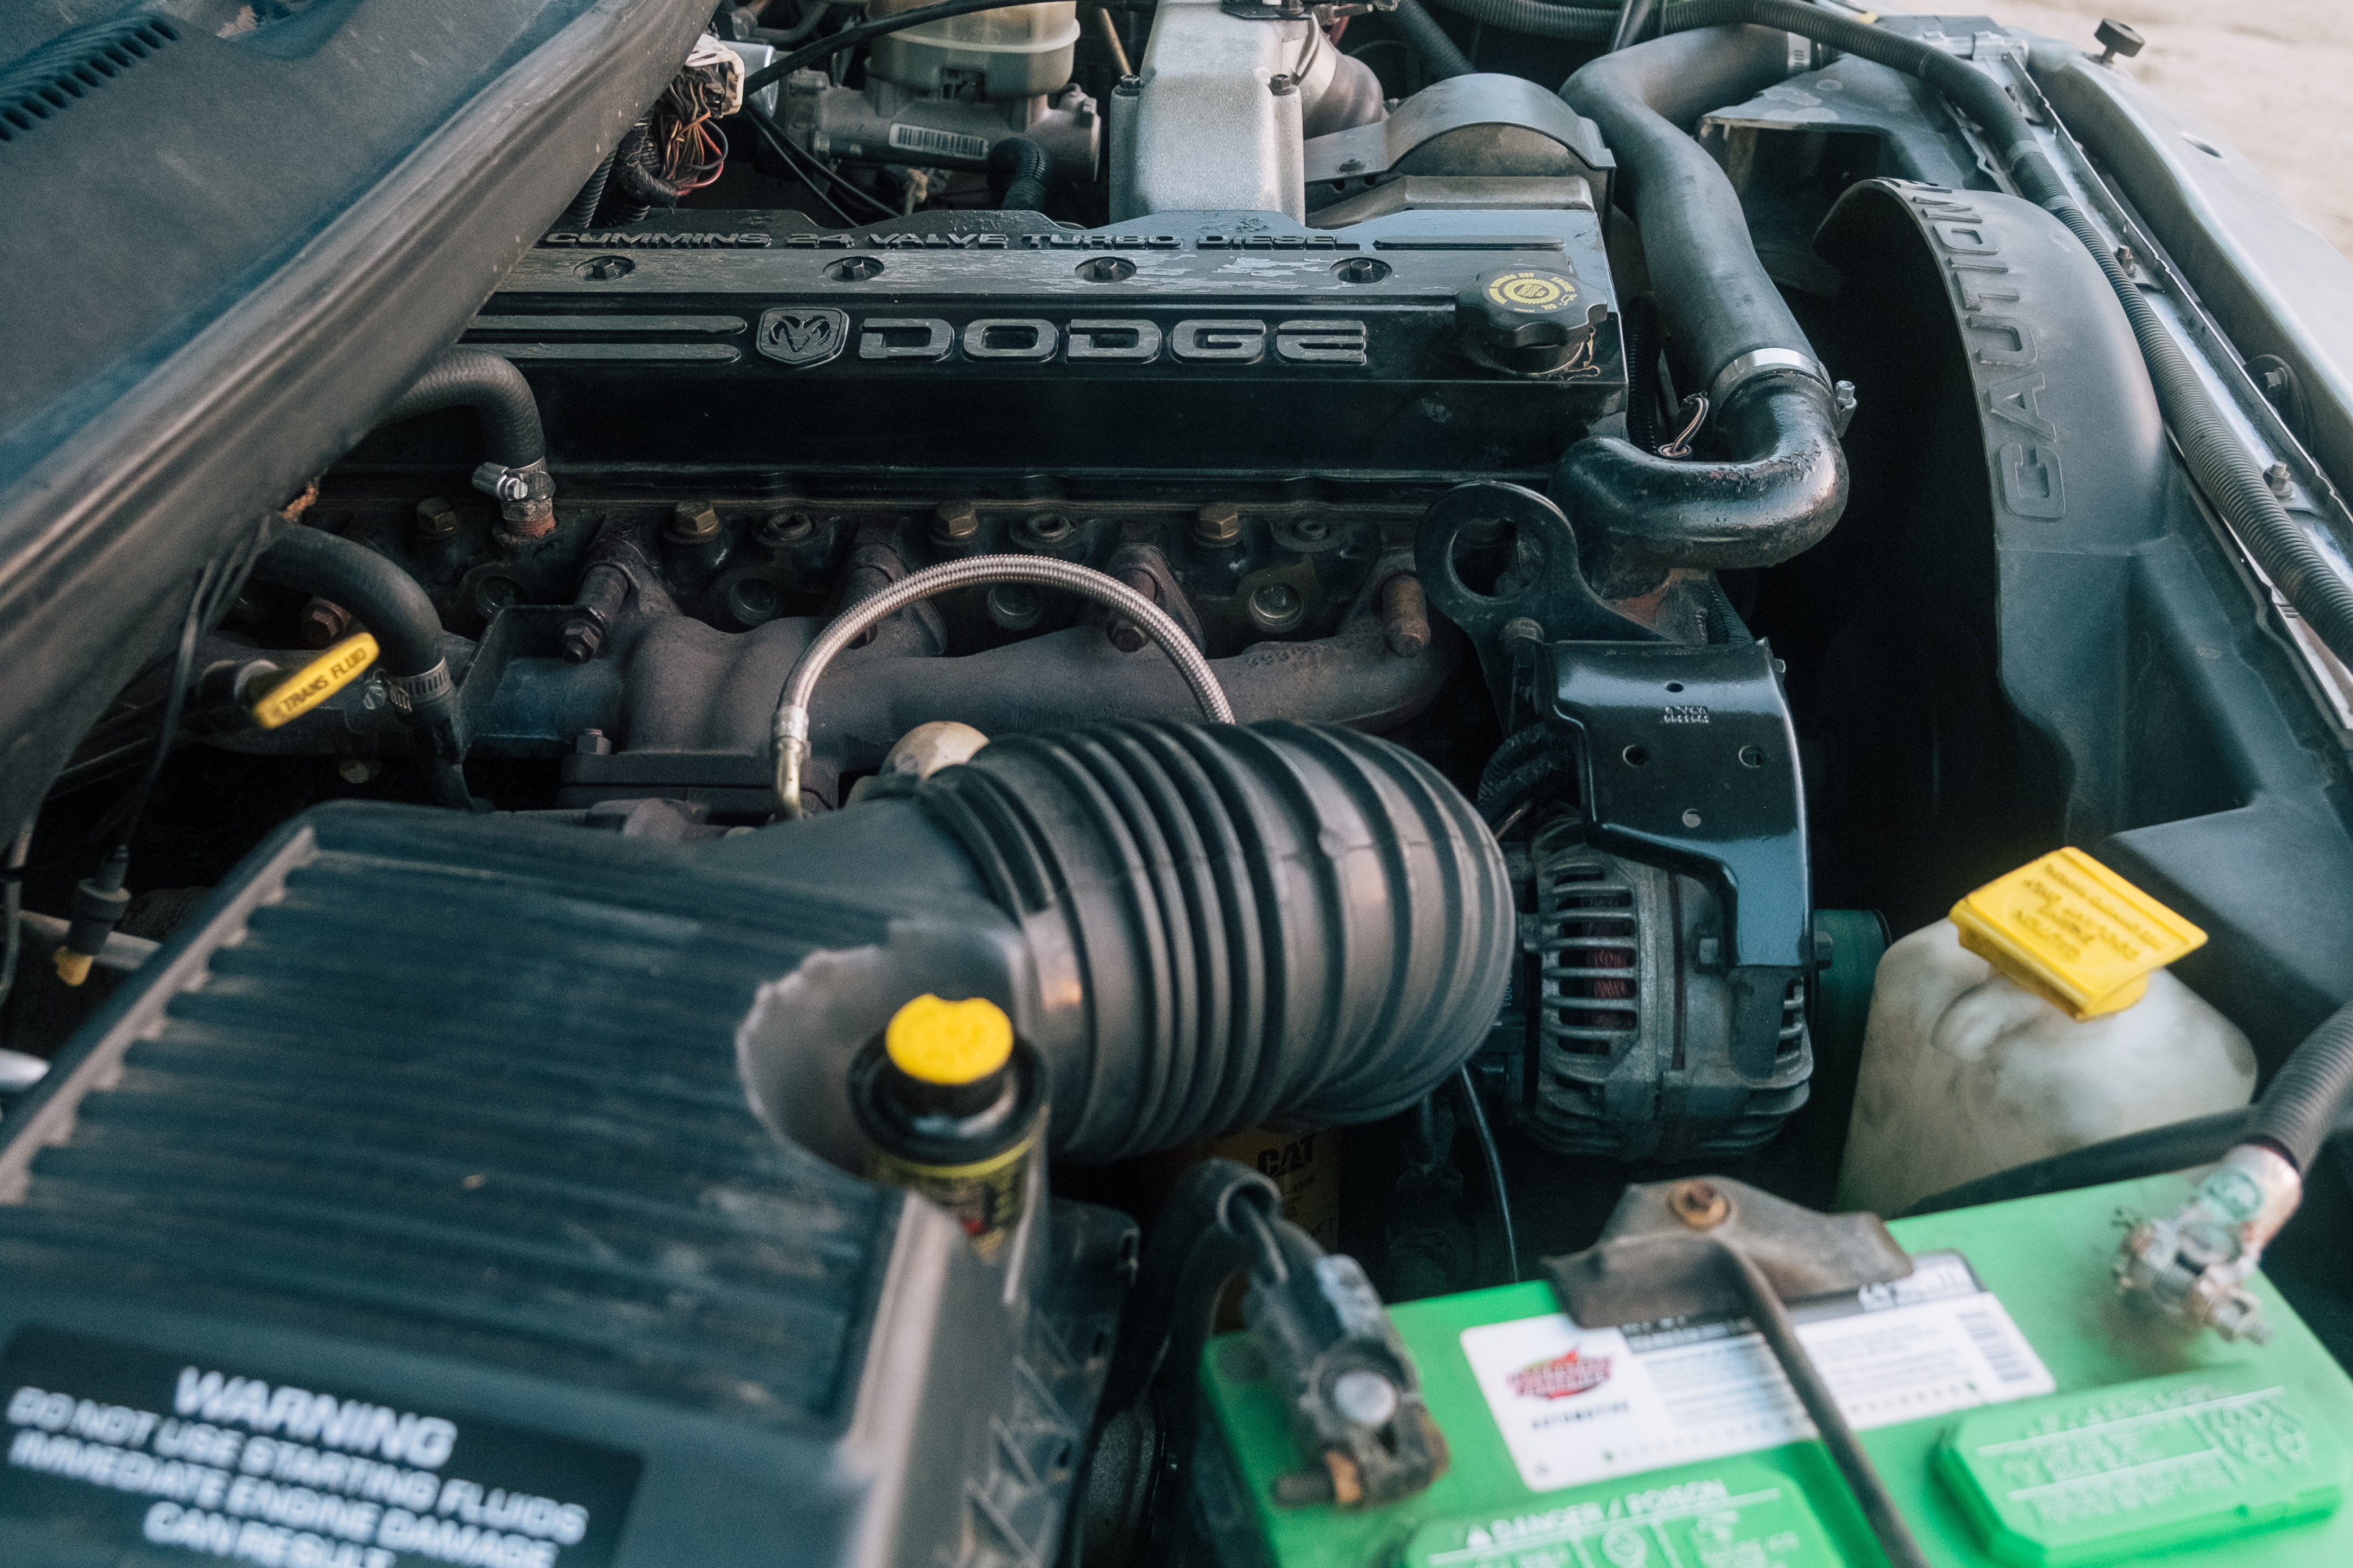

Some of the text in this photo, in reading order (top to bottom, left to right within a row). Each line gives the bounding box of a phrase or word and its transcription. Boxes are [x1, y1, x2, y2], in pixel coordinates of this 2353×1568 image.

[546, 232, 1361, 250] CUMMINS 24 VALVE TURBO DIESEL
[859, 318, 1366, 365] DODGE
[1911, 195, 2066, 520] CAUTION
[280, 647, 367, 711] TRANS FLUID
[1257, 1131, 1316, 1178] CAT
[175, 1366, 457, 1468] WARNING
[7, 1386, 589, 1545] DO NOT USE STARTING FLUIDS
[8, 1429, 558, 1568] IMMEDIATE ENGINE DAMAGE
[144, 1501, 240, 1556] CAN
[1491, 1502, 1604, 1543] DANGER
[1626, 1479, 1729, 1515] POISON
